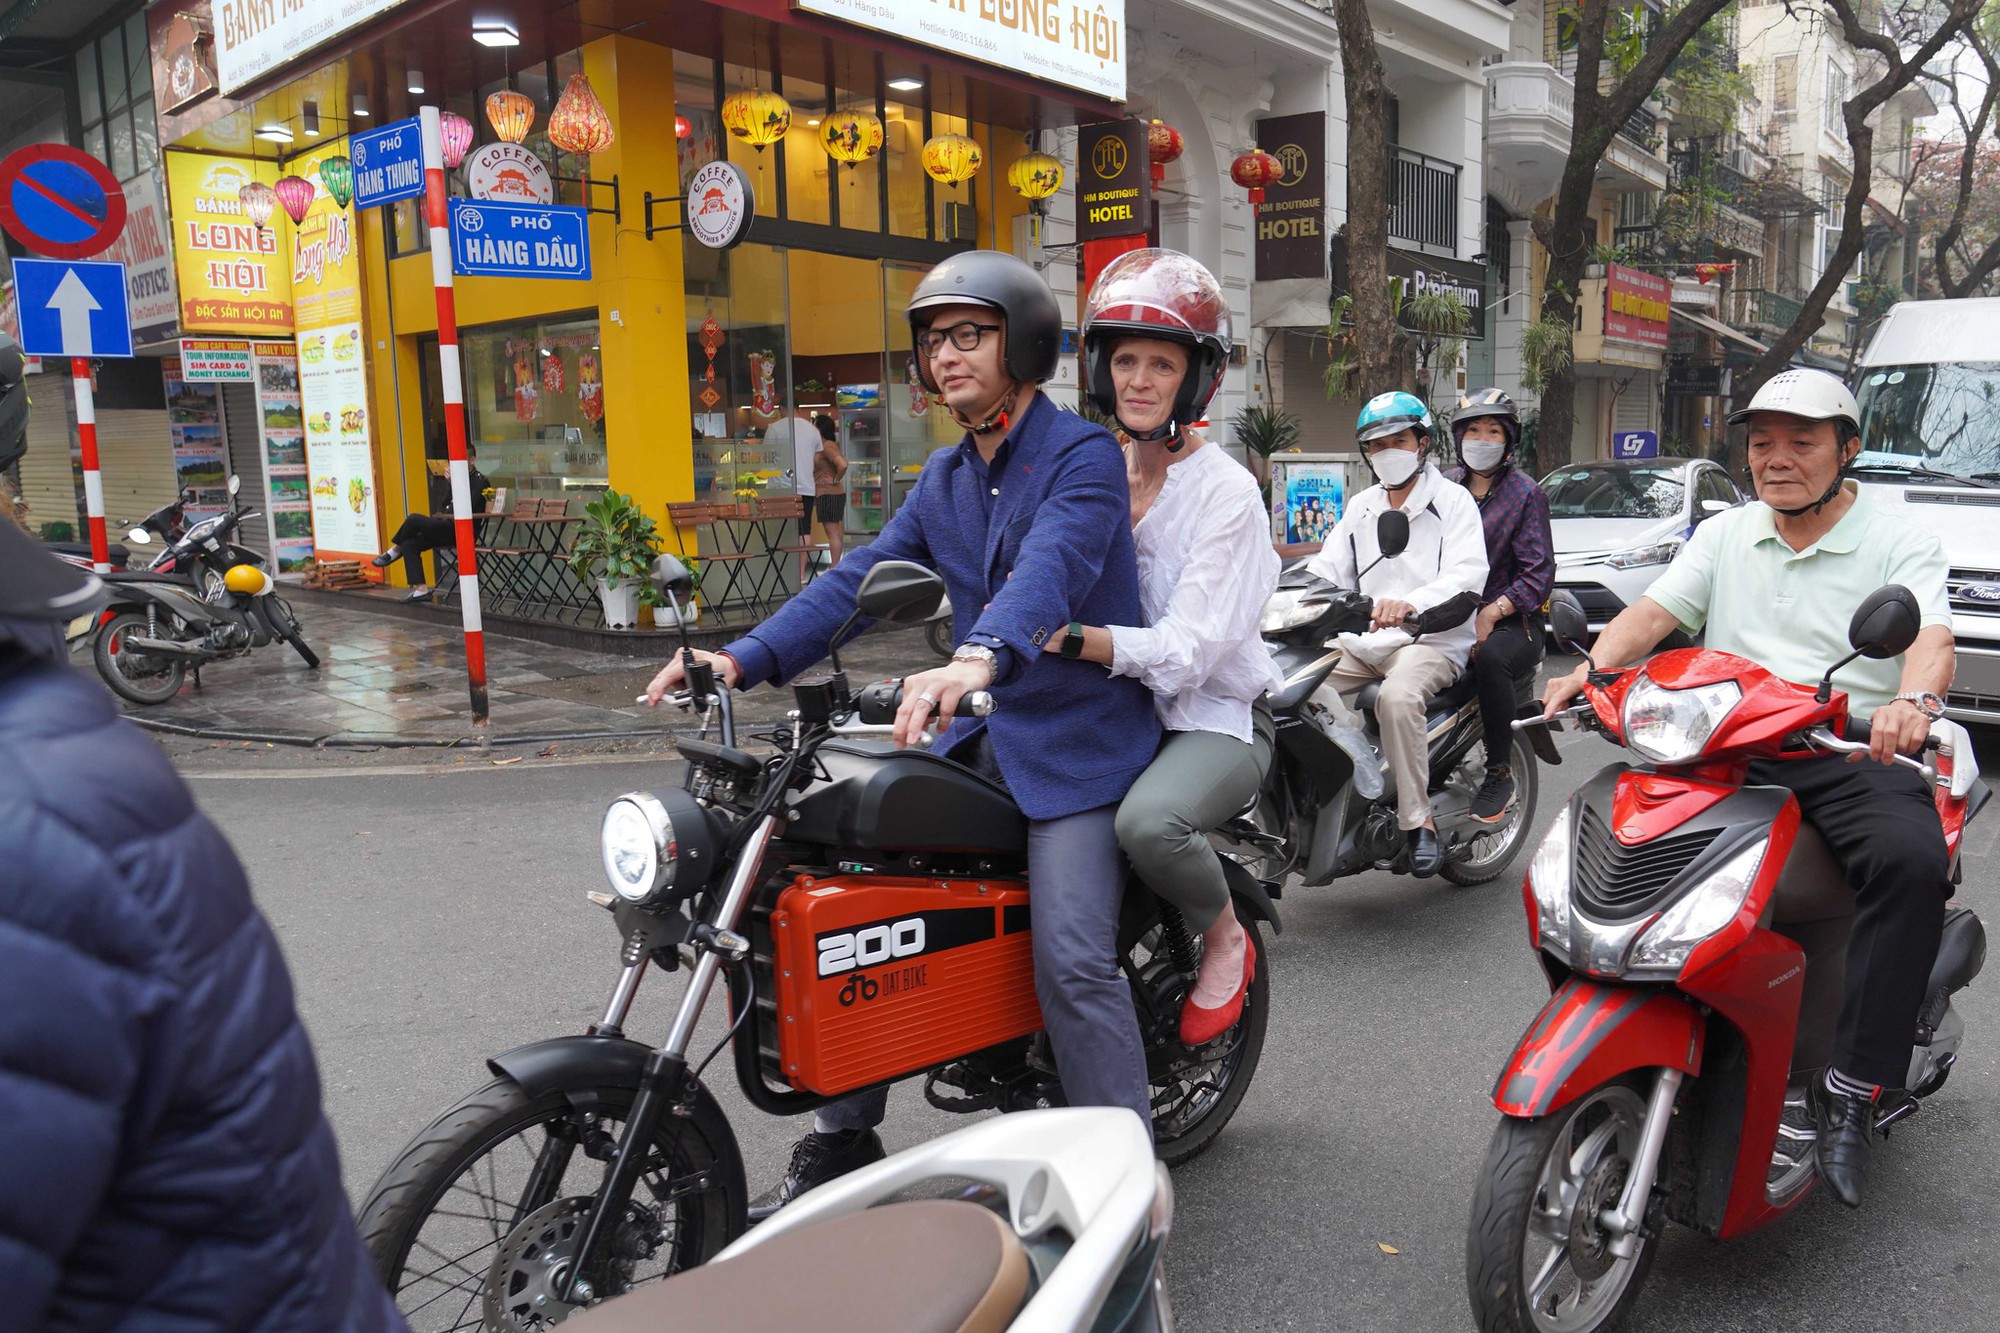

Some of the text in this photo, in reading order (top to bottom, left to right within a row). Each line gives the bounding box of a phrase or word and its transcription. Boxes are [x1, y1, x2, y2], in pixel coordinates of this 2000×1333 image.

[920, 19, 998, 52] Hotline: 0835.116.866
[1070, 4, 1119, 68] HỘI
[1023, 51, 1049, 67] Website:
[379, 130, 402, 153] PHỐ
[481, 147, 543, 174] COFFEE
[358, 157, 420, 197] HÀNG THÙNG
[694, 166, 734, 193] COFFEE
[195, 196, 242, 215] BÁNH
[1083, 188, 1139, 203] HM BOUTIQUE
[1259, 198, 1321, 212] HM BOUTIQUE
[511, 213, 552, 230] PHỐ
[1090, 204, 1134, 223] HOTEL
[186, 221, 277, 253] LONG
[691, 217, 720, 243] SMOOTHIES
[726, 210, 738, 235] JUICE
[1259, 217, 1320, 240] HOTEL
[466, 234, 578, 267] HÀNG DẦU
[131, 266, 170, 300] OFFICE
[207, 258, 266, 295] HỘI
[195, 302, 284, 322] ĐẶC SẢN HỘI AN
[185, 352, 249, 360] TOUR INFORMATION
[256, 345, 279, 355] DAILY
[188, 370, 213, 378] MONEY
[215, 370, 250, 378] EXCHANGE
[1062, 366, 1068, 378] 3
[1623, 434, 1645, 456] G7
[817, 917, 926, 976] 200
[882, 964, 928, 996] DAT.BIKE
[1768, 965, 1801, 989] HONDA
